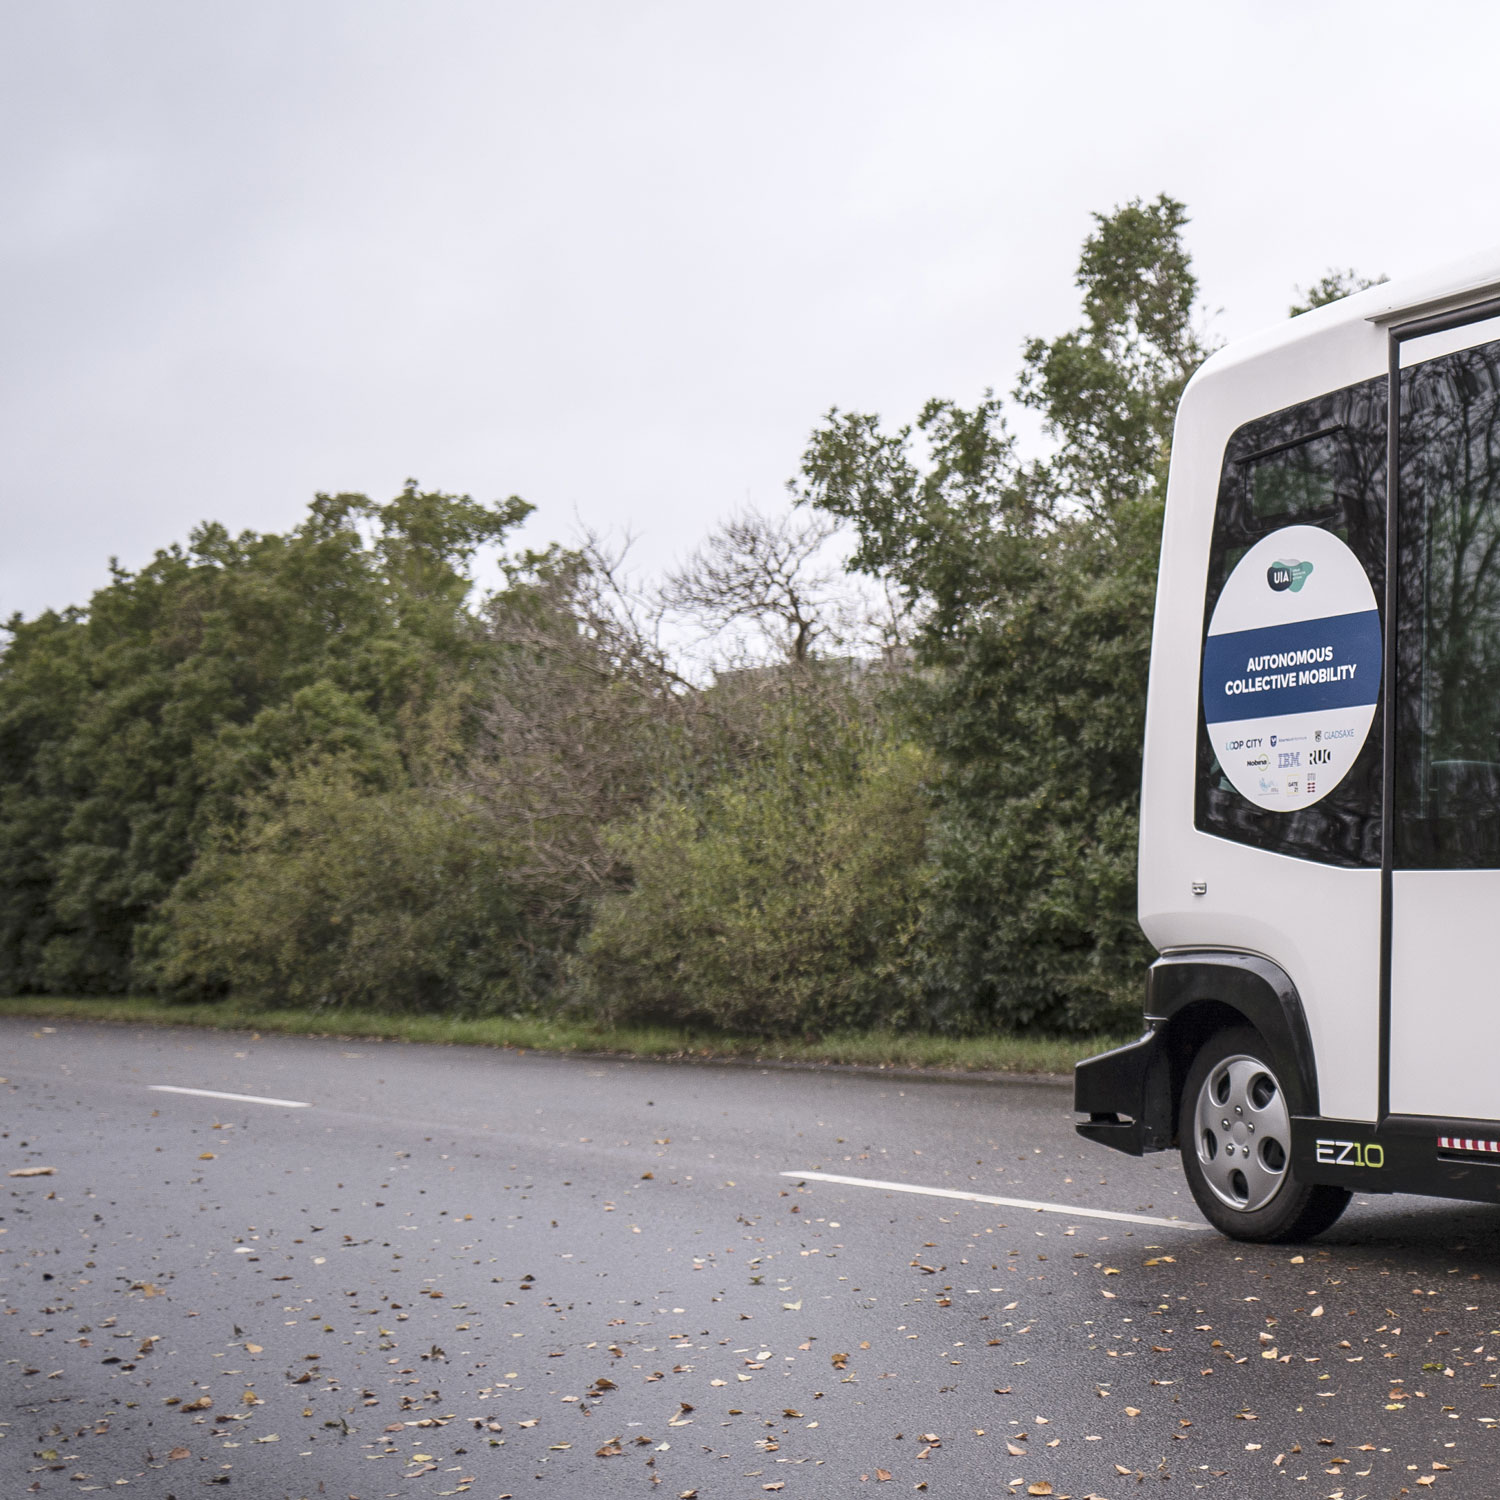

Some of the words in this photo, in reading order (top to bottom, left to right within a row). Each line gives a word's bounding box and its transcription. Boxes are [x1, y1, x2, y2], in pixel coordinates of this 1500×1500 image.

[1274, 571, 1289, 584] UIA
[1247, 646, 1333, 672] AUTONOMOUS
[1225, 671, 1297, 695] COLLECTIVE
[1298, 664, 1357, 685] MOBILITY
[1324, 728, 1354, 740] GLADSAXE
[1225, 740, 1244, 751] LOOP
[1246, 738, 1263, 749] CITY
[1278, 752, 1301, 768] IBM
[1309, 750, 1331, 765] RUC
[1316, 1140, 1384, 1168] EZ10
